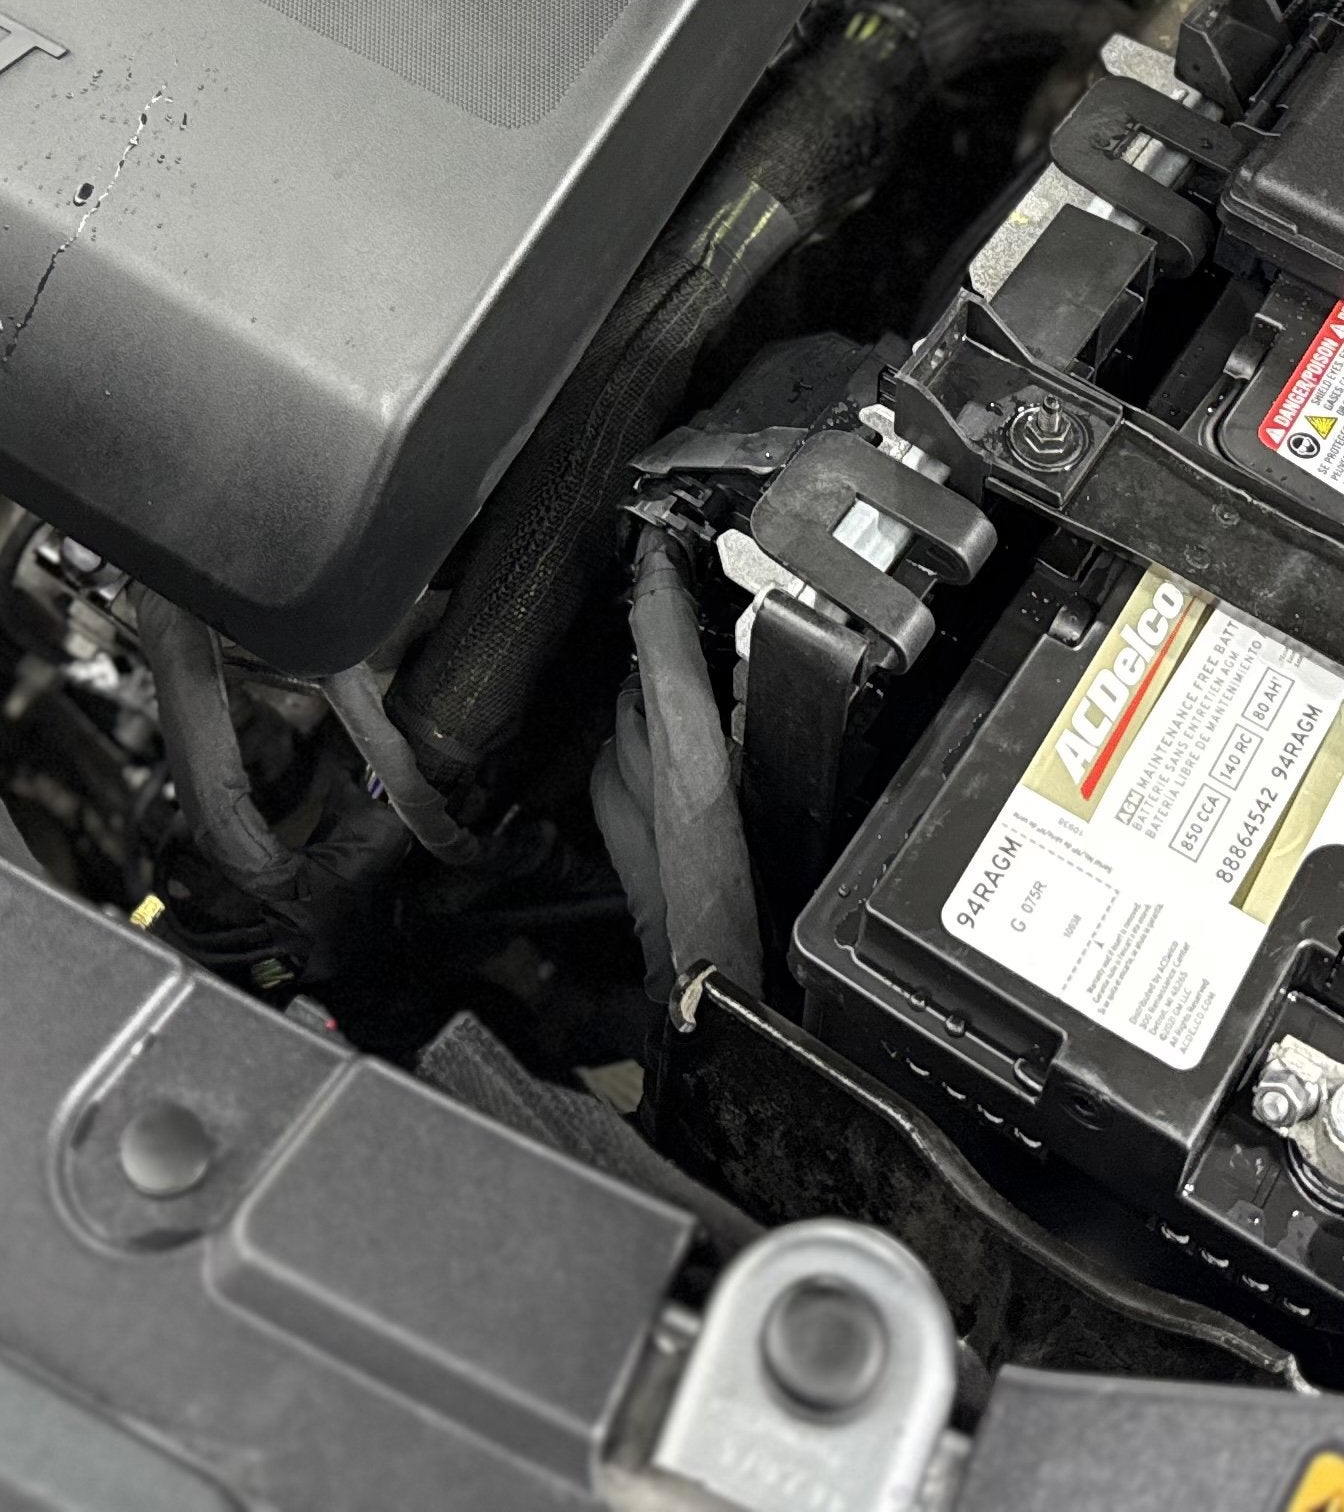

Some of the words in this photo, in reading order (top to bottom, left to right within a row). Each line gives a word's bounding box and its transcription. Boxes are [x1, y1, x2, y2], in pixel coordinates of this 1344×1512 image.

[1275, 338, 1338, 428] DANGER/POISON
[1317, 463, 1330, 475] SE
[1053, 580, 1186, 784] ACDelco
[1174, 751, 1200, 787] LIBRE
[1194, 733, 1211, 751] DE
[1206, 640, 1262, 732] MANTENIMIENTO
[1252, 702, 1270, 721] 80
[1118, 791, 1143, 825] AGM
[1137, 692, 1198, 789] MAINTENANCE
[1193, 656, 1219, 691] FREE
[1131, 774, 1170, 831] BATTERIE
[1164, 741, 1189, 773] SANS
[1183, 677, 1225, 740] ENTRETIEN
[1220, 650, 1240, 676] AGM
[1220, 754, 1241, 780] 140
[1234, 733, 1253, 754] RC
[1180, 823, 1203, 852] 850
[1196, 796, 1220, 823] CCA
[1216, 787, 1278, 883] 88864542
[1271, 704, 1322, 779] 94RAGM
[957, 837, 1021, 928] 94RAGM
[1010, 918, 1027, 933] G
[1021, 880, 1047, 914] 075R
[1172, 1003, 1183, 1016] GM
[1179, 987, 1192, 1004] LLC
